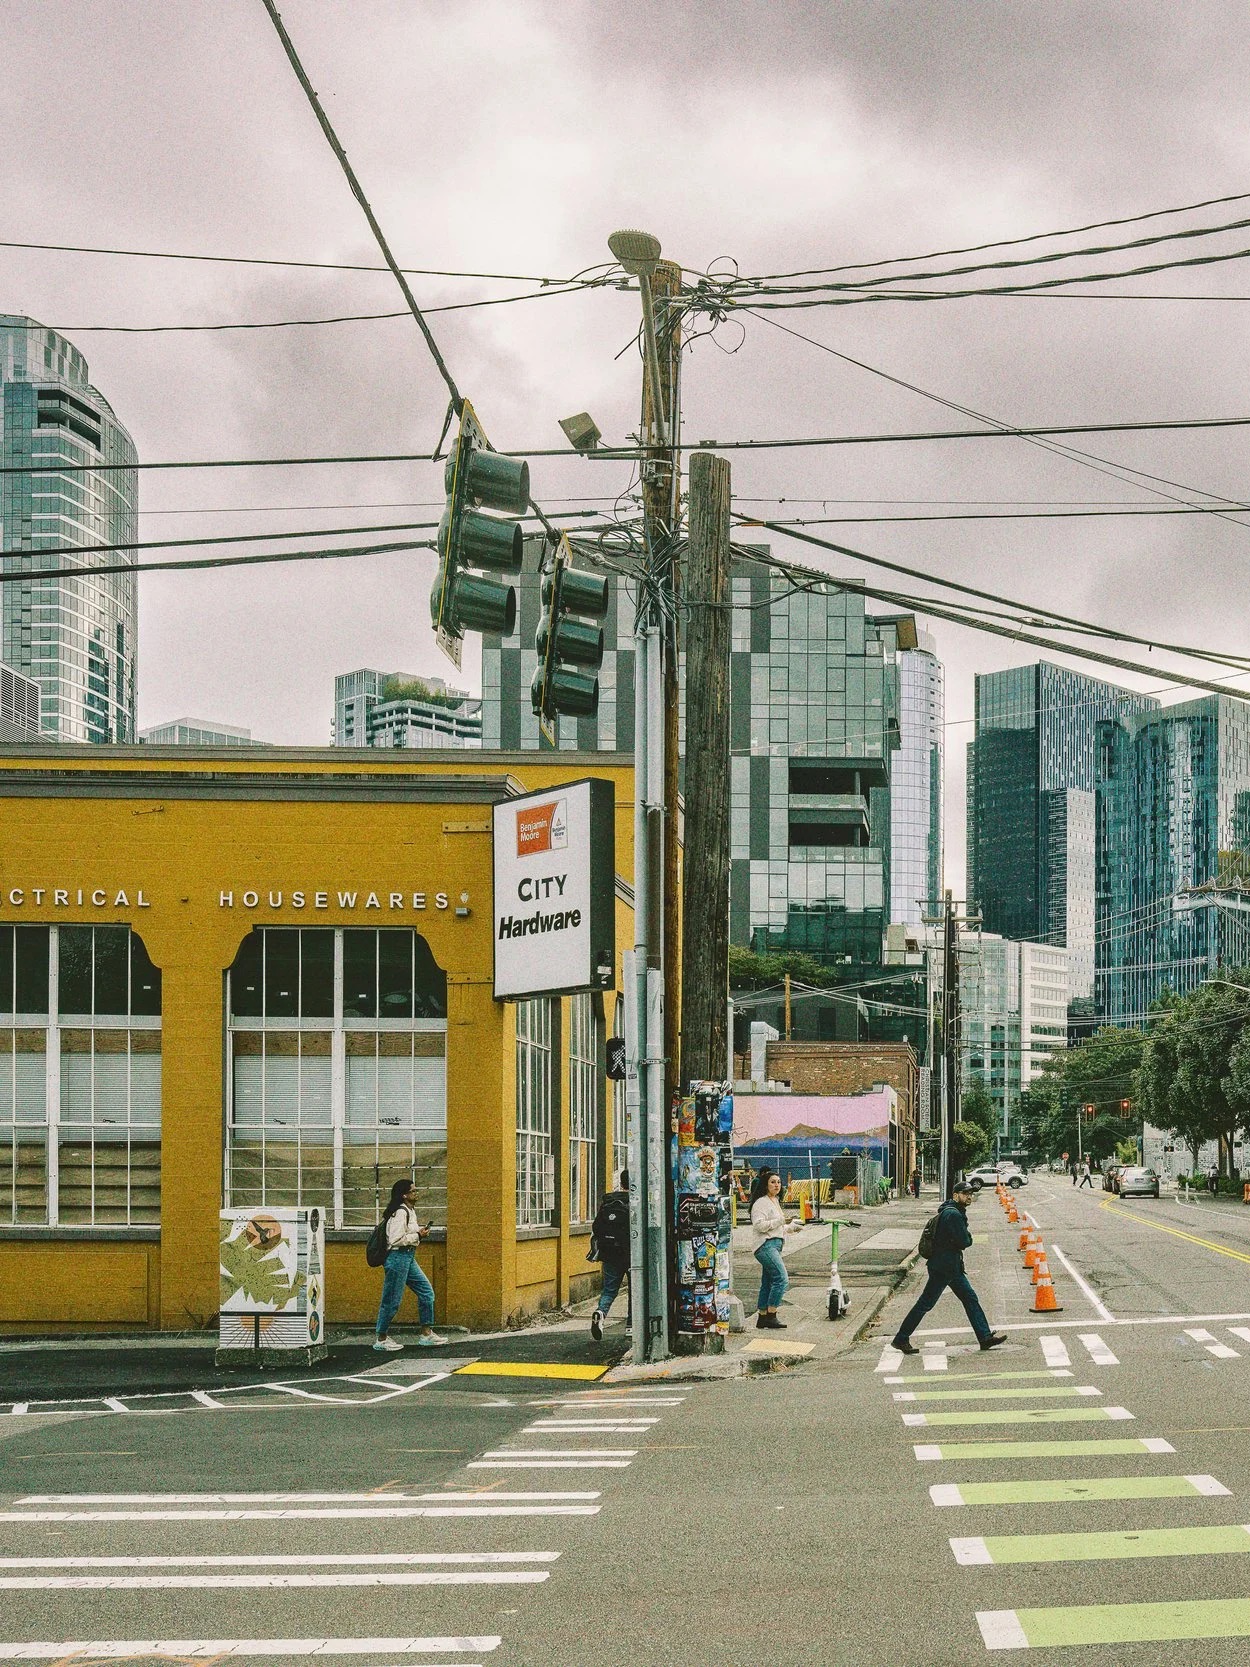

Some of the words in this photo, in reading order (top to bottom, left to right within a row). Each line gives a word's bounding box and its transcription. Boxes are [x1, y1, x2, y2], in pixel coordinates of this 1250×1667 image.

[520, 818, 548, 833] Benjamin
[520, 831, 540, 842] Moore
[517, 873, 568, 902] CITY
[0, 888, 150, 907] CTRICAL
[219, 890, 449, 909] HOUSEWARES
[498, 908, 582, 940] Hardware
